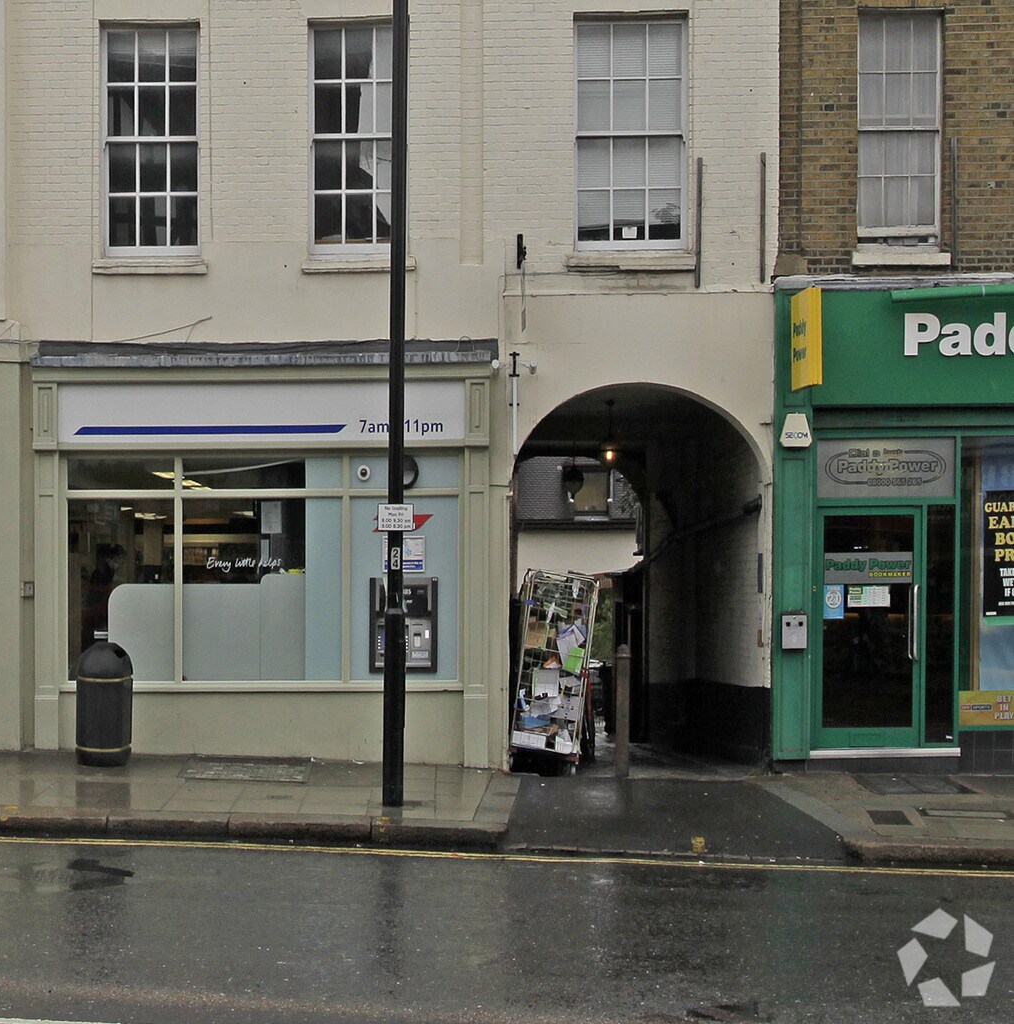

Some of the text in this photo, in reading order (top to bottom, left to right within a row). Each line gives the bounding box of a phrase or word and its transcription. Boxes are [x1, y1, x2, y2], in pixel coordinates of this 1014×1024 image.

[904, 312, 1014, 356] Pad
[359, 419, 444, 436] 7am 11pm
[785, 431, 808, 439] SECOM
[837, 458, 939, 475] Paddy Power
[206, 557, 282, 574] Every little helps
[825, 558, 912, 572] Paddy Power
[997, 695, 1012, 703] BET
[1000, 703, 1009, 711] IN
[994, 712, 1014, 720] PLAY
